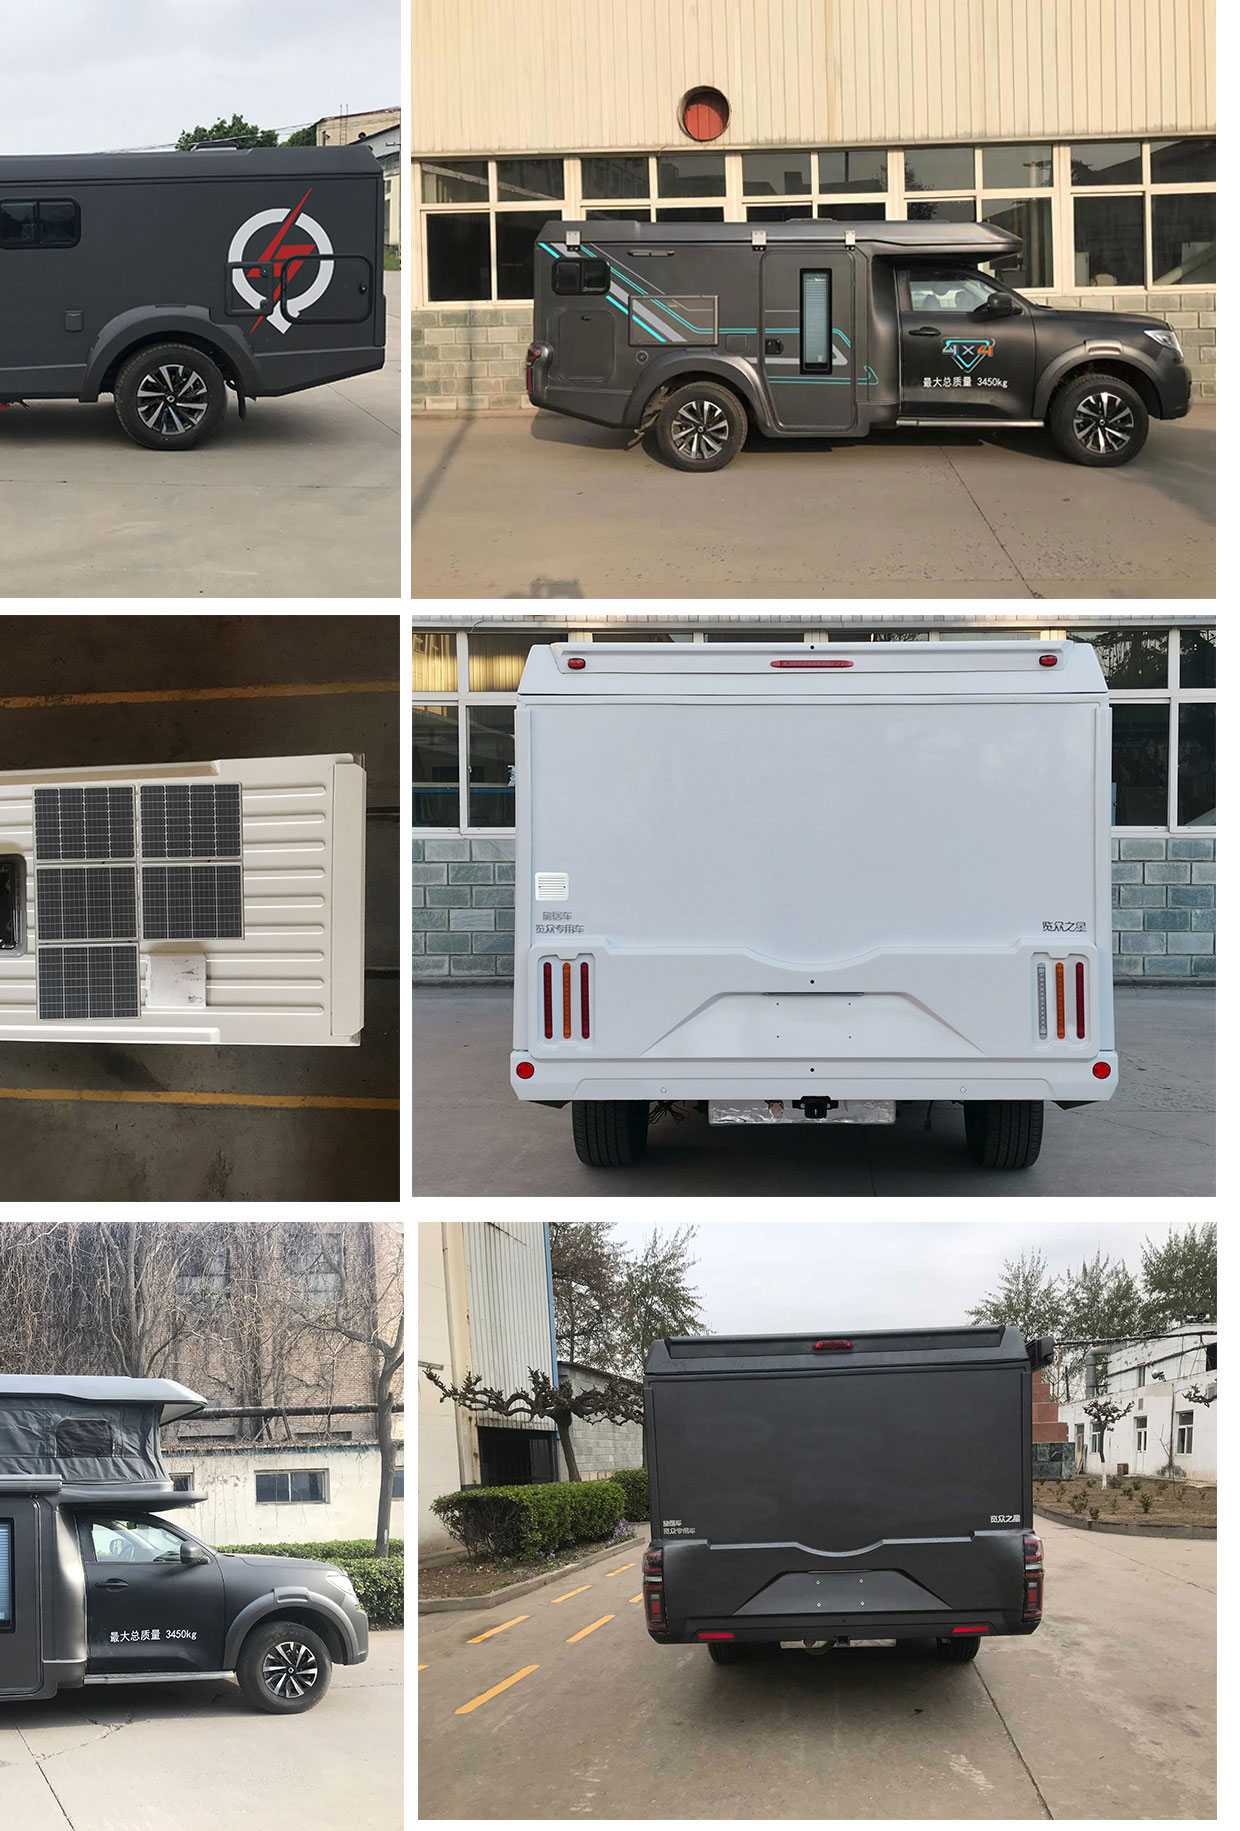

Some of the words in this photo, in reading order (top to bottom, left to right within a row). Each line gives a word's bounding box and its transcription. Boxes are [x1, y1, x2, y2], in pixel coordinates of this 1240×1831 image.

[923, 376, 972, 388] 最大总质量
[977, 377, 1009, 389] 3450kg
[110, 1629, 161, 1643] 最大总质量
[165, 1629, 198, 1641] 3450kg
